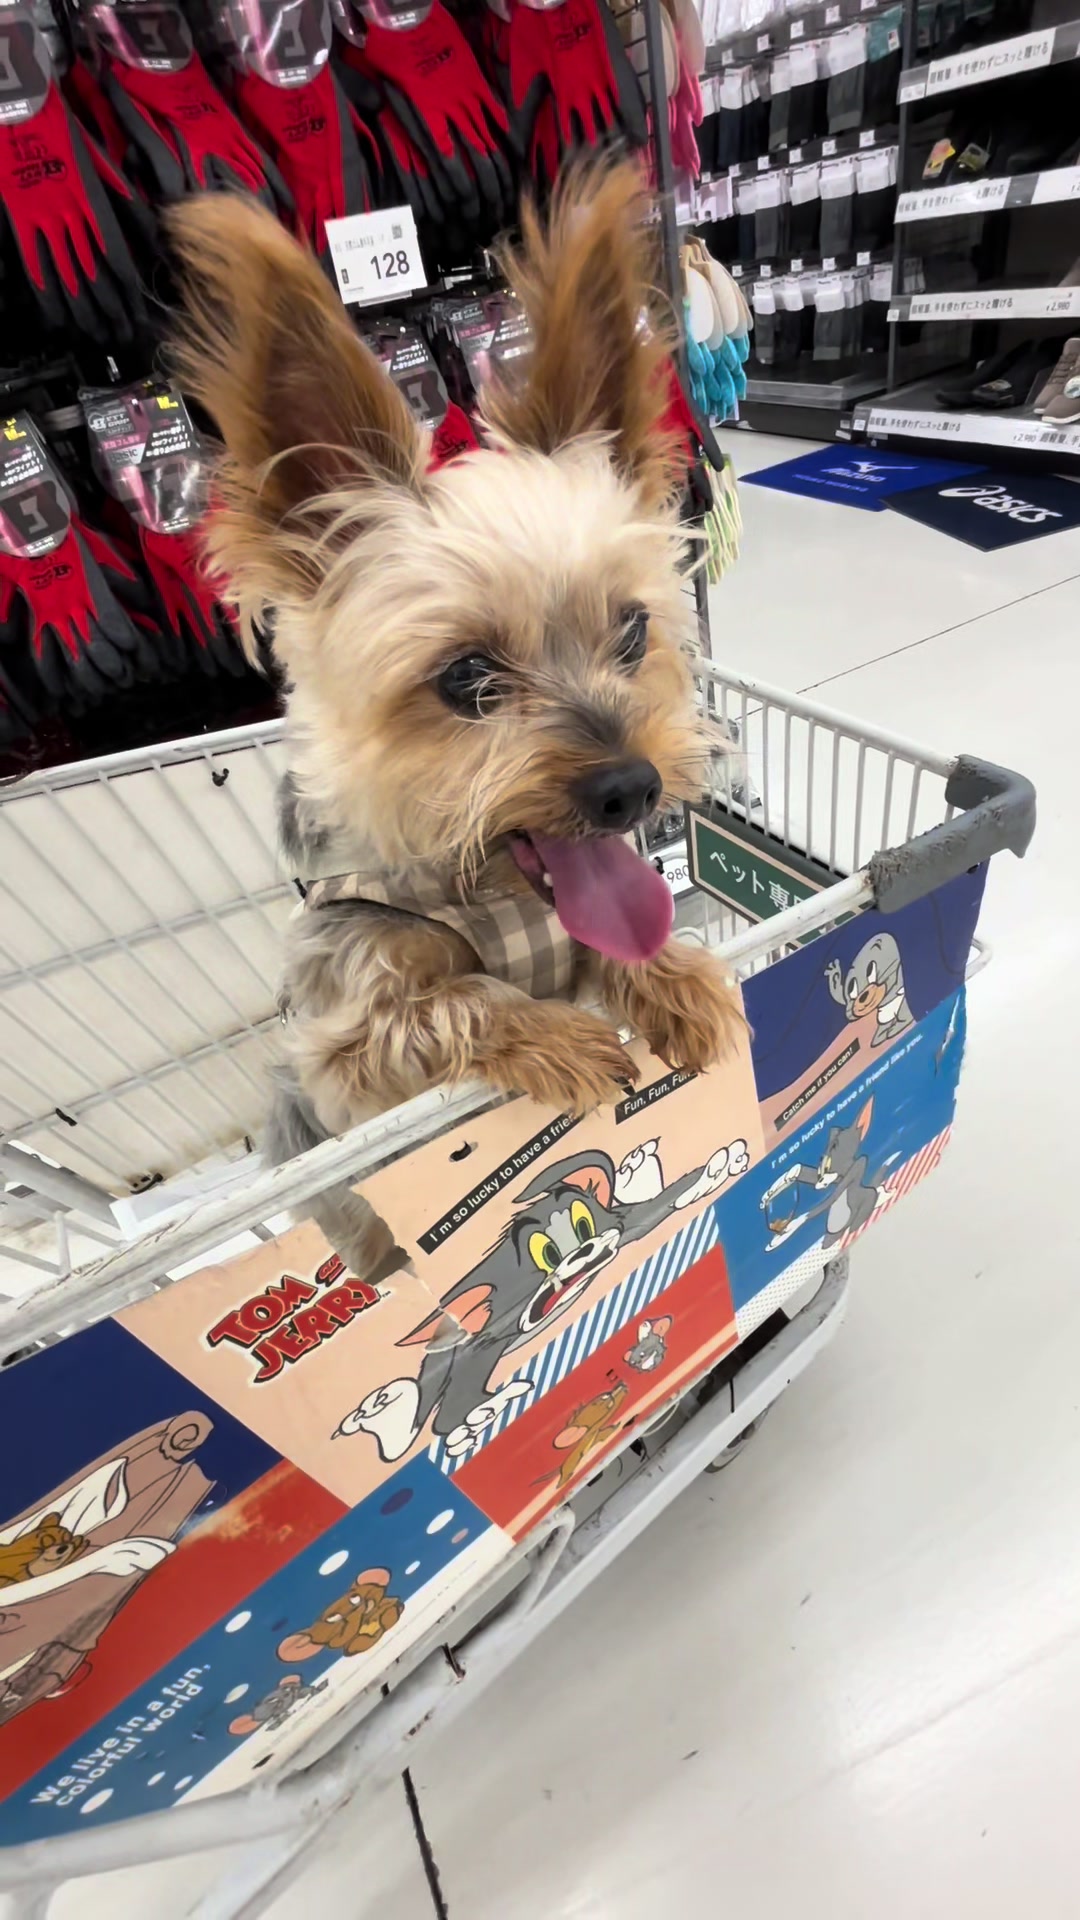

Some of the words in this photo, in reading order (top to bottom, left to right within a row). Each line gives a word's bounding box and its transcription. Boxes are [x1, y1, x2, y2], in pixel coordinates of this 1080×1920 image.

[370, 250, 410, 280] 128
[624, 1096, 646, 1115] Fun,
[648, 1082, 670, 1101] Fun,
[782, 1098, 804, 1121] Catch
[805, 1086, 817, 1099] me
[817, 1078, 823, 1087] if
[823, 1065, 837, 1083] you
[837, 1047, 853, 1066] can!
[788, 1142, 800, 1154] so
[801, 1119, 825, 1143] lucky
[826, 1110, 836, 1121] to
[836, 1091, 858, 1112] have
[858, 1085, 864, 1093] a
[865, 1061, 889, 1087] friend
[890, 1048, 906, 1064] like
[906, 1033, 924, 1052] you.
[452, 1207, 468, 1222] so
[467, 1178, 500, 1208] lucky
[499, 1167, 513, 1180] to
[512, 1142, 542, 1168] have
[542, 1135, 550, 1144] a
[206, 1274, 319, 1348] TOM
[251, 1277, 382, 1384] JERRY
[29, 1774, 74, 1805] We
[72, 1735, 120, 1771] live
[116, 1715, 146, 1734] in
[147, 1700, 165, 1712] a
[161, 1664, 211, 1696] fun,
[55, 1737, 142, 1807] colorful
[141, 1683, 203, 1732] world
